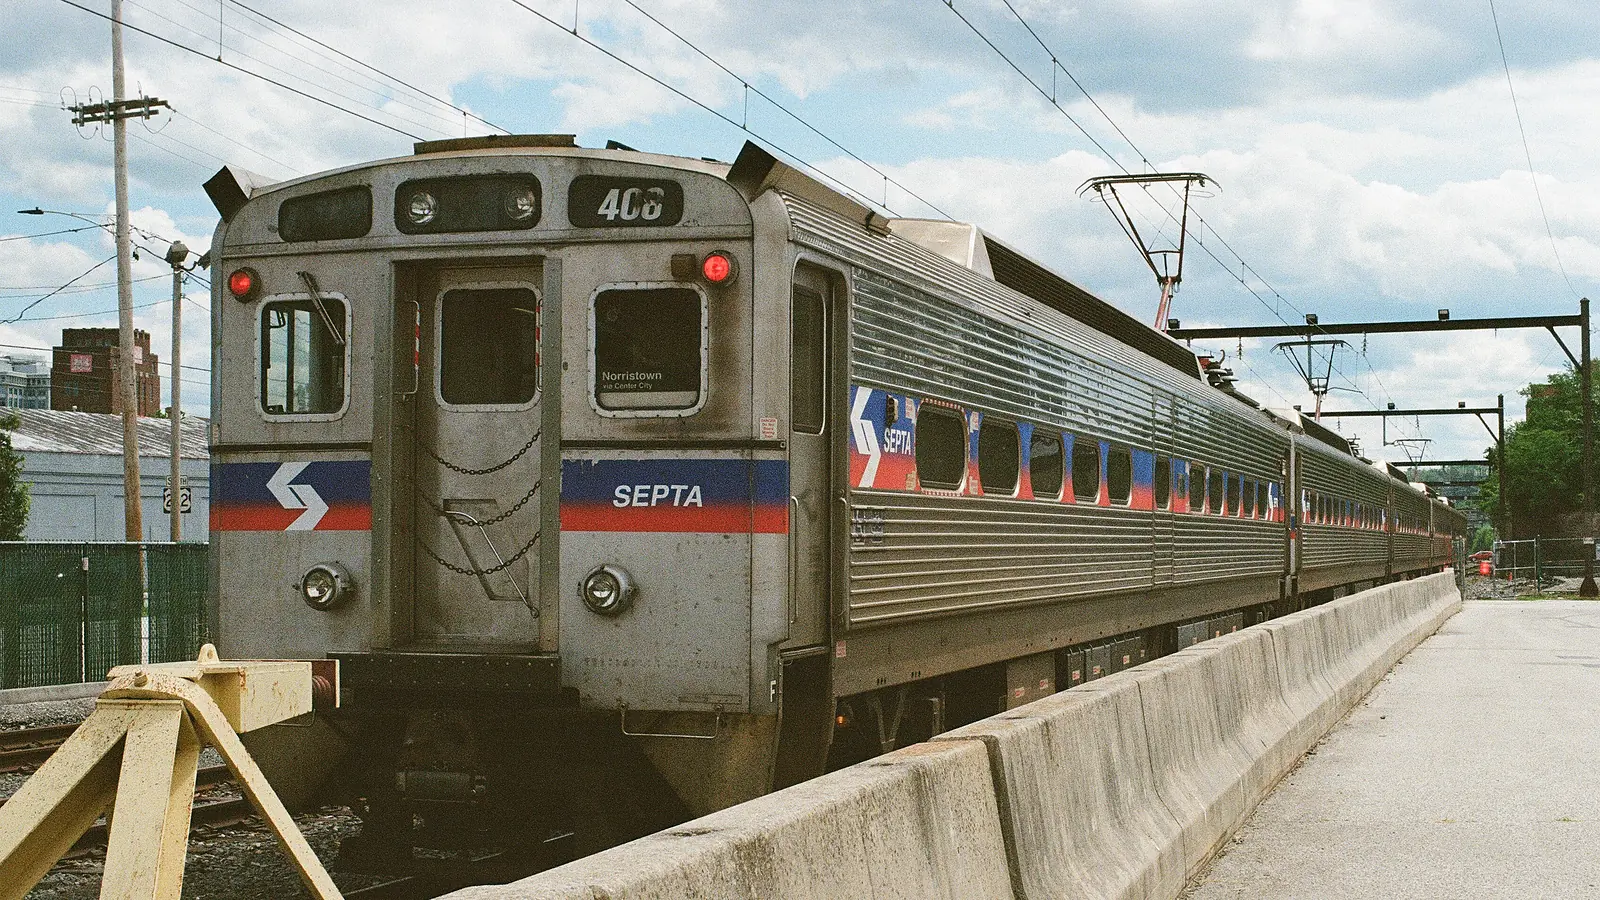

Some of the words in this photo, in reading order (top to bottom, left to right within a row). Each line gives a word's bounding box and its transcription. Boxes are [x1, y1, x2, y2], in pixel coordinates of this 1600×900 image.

[597, 187, 665, 221] 408
[602, 371, 662, 381] Norristown
[638, 382, 653, 390] City
[883, 428, 911, 455] SEPTA
[166, 493, 189, 507] 22
[612, 484, 703, 508] SEPTA
